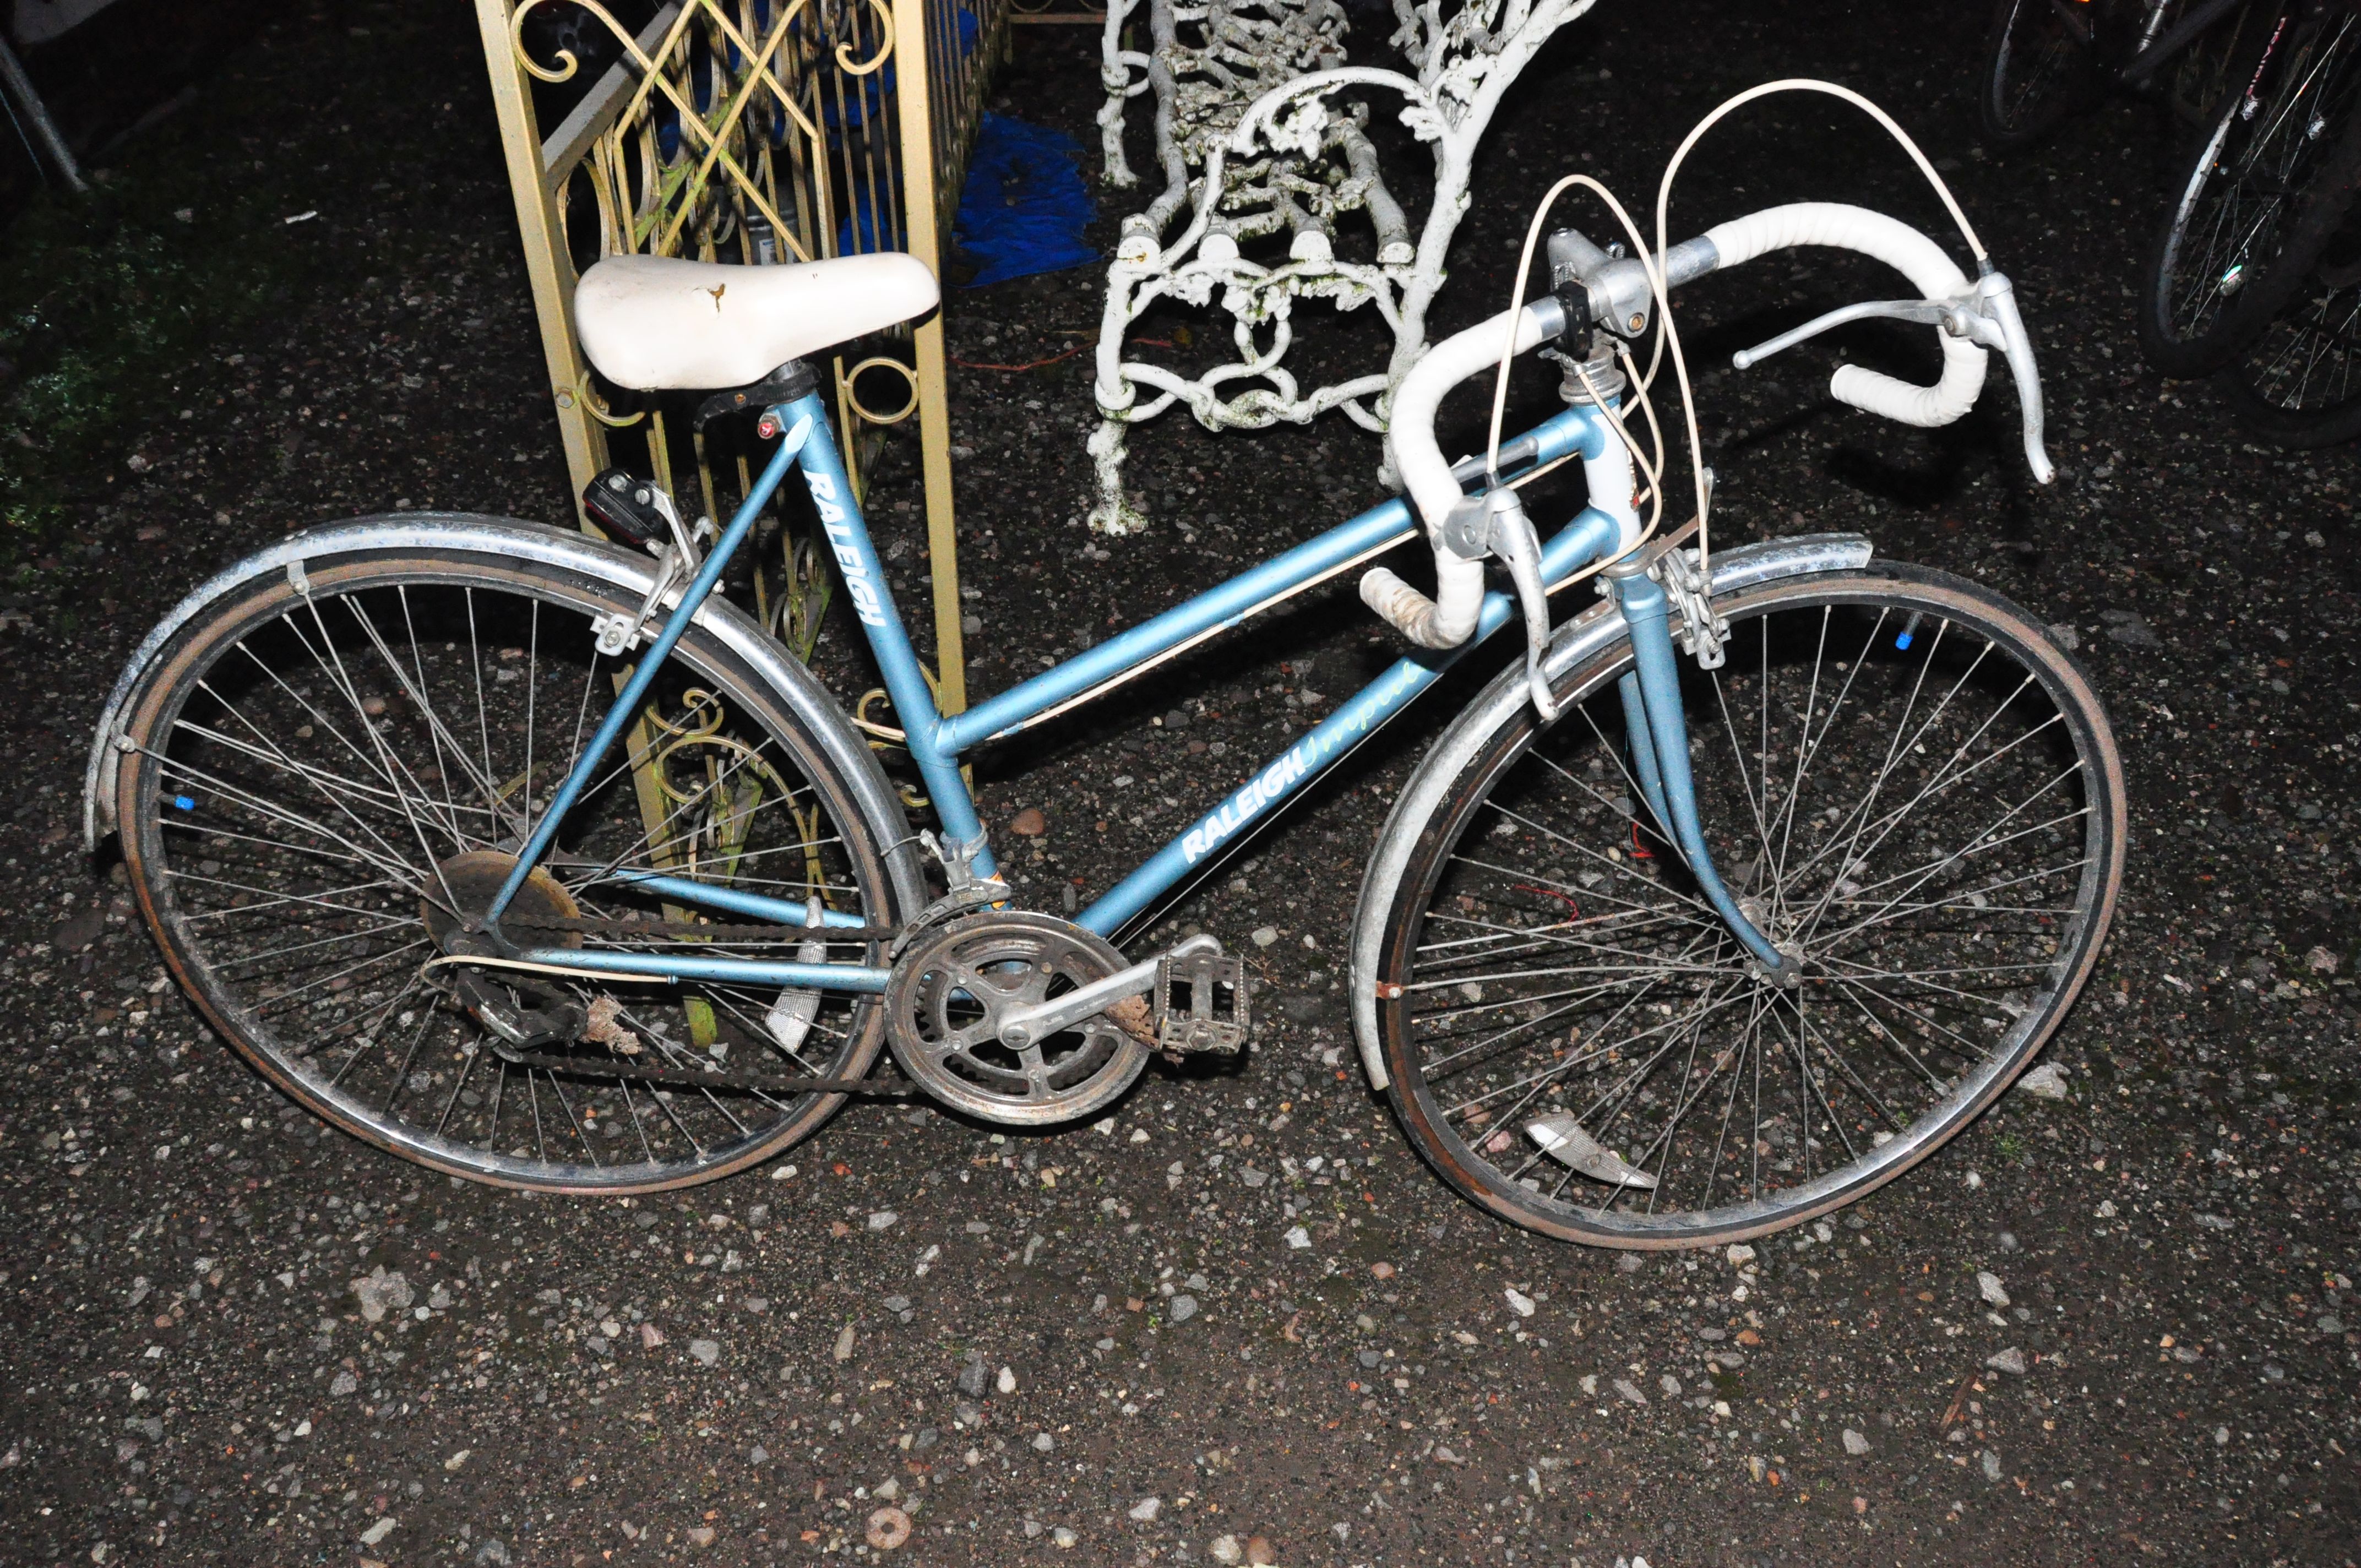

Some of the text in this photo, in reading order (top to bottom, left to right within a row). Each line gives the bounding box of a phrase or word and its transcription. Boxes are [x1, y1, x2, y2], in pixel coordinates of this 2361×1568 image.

[802, 470, 886, 627] RALEIGH
[1182, 662, 1427, 863] RALEIGH Impul
